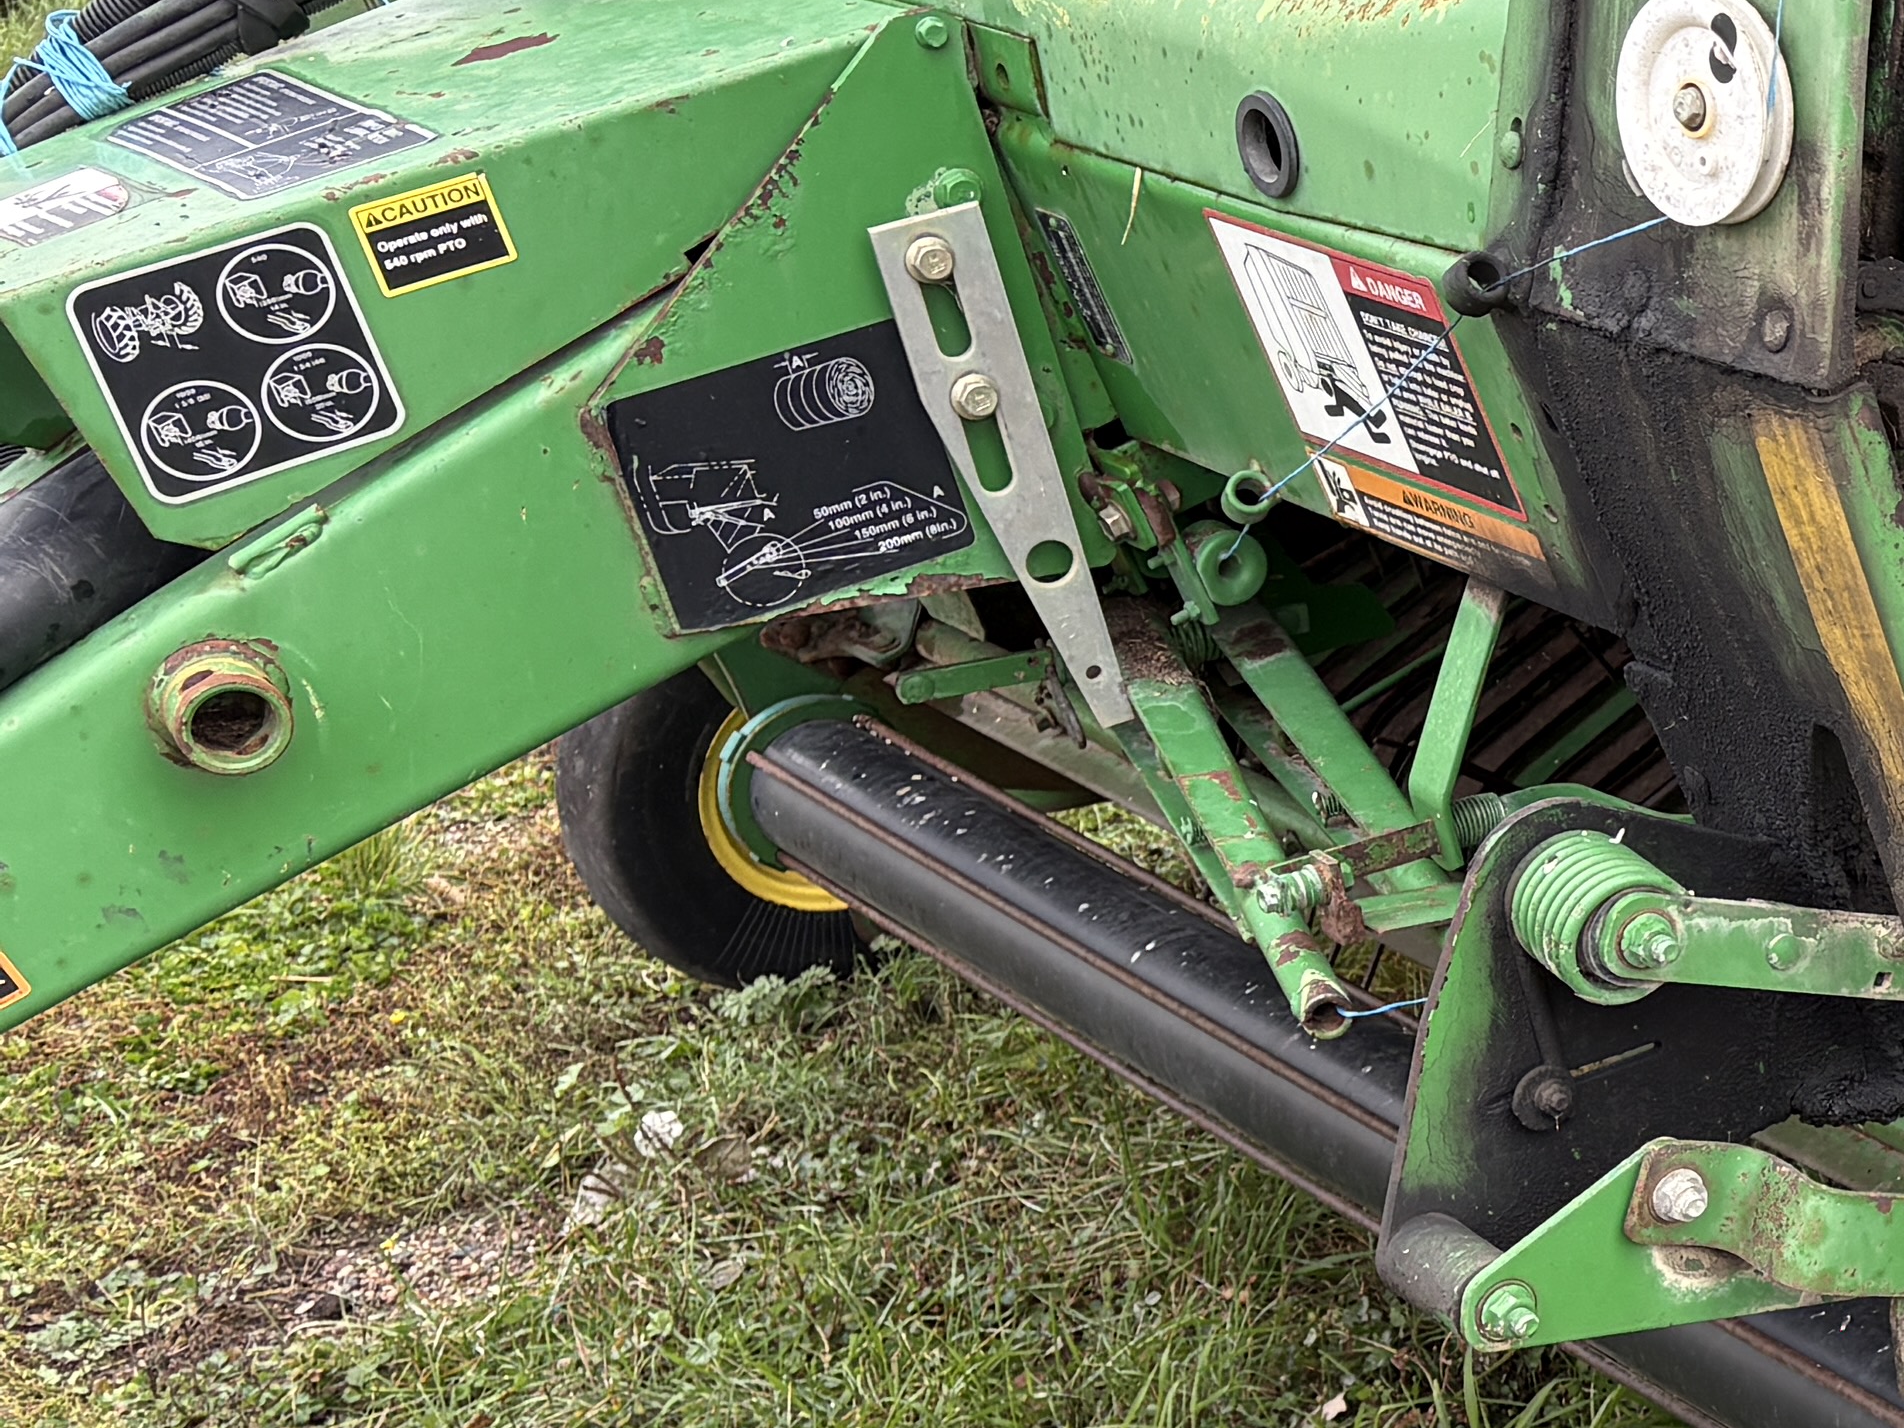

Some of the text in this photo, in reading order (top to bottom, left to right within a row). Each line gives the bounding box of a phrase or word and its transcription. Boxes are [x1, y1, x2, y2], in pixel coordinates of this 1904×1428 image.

[381, 183, 480, 222] CAUTION
[377, 213, 488, 253] Operate only with
[384, 238, 467, 271] 540 rpm PTO
[1366, 277, 1427, 312] DANGER
[791, 355, 803, 369] A
[813, 486, 891, 520] 50mm (2 in.)
[933, 485, 945, 498] A
[763, 507, 776, 522] A
[828, 496, 912, 531] 100mm (4 in.)
[854, 519, 900, 541] 150mm
[916, 505, 937, 521] in.)
[1409, 491, 1475, 529] WARNING
[878, 530, 924, 552] 200mm
